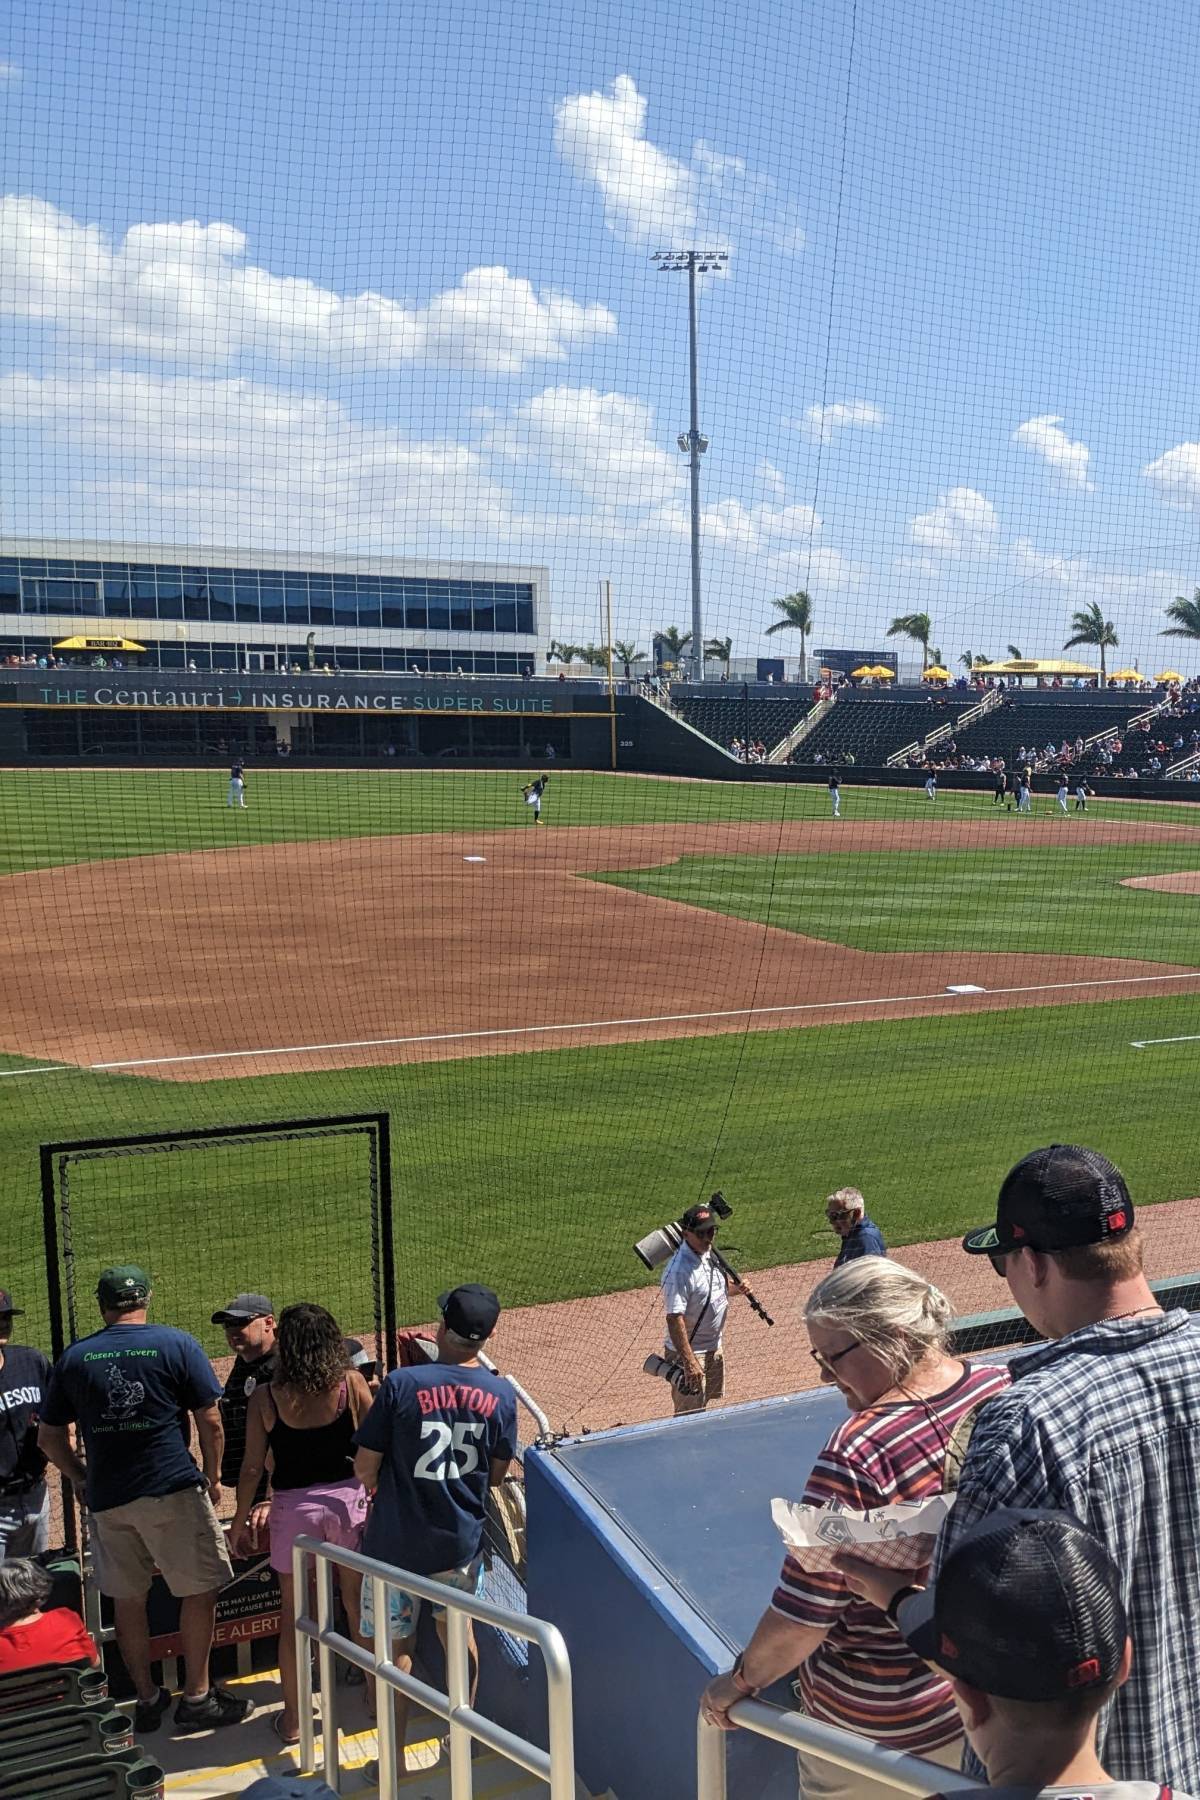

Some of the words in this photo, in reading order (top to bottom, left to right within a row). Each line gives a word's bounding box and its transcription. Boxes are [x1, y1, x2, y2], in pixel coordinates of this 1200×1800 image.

[39, 688, 88, 705] THE
[94, 687, 225, 707] Centauri
[413, 695, 484, 711] SUPER
[493, 697, 553, 713] SUITE
[125, 1349, 158, 1357] Tavern
[416, 1385, 499, 1418] BUXTON
[414, 1421, 485, 1480] 25
[224, 1608, 239, 1616] MAY
[240, 1602, 263, 1612] CAUSE
[264, 1599, 280, 1608] INJU
[231, 1597, 245, 1605] MAY
[248, 1591, 269, 1602] LEAVE
[230, 1616, 280, 1639] ALERT
